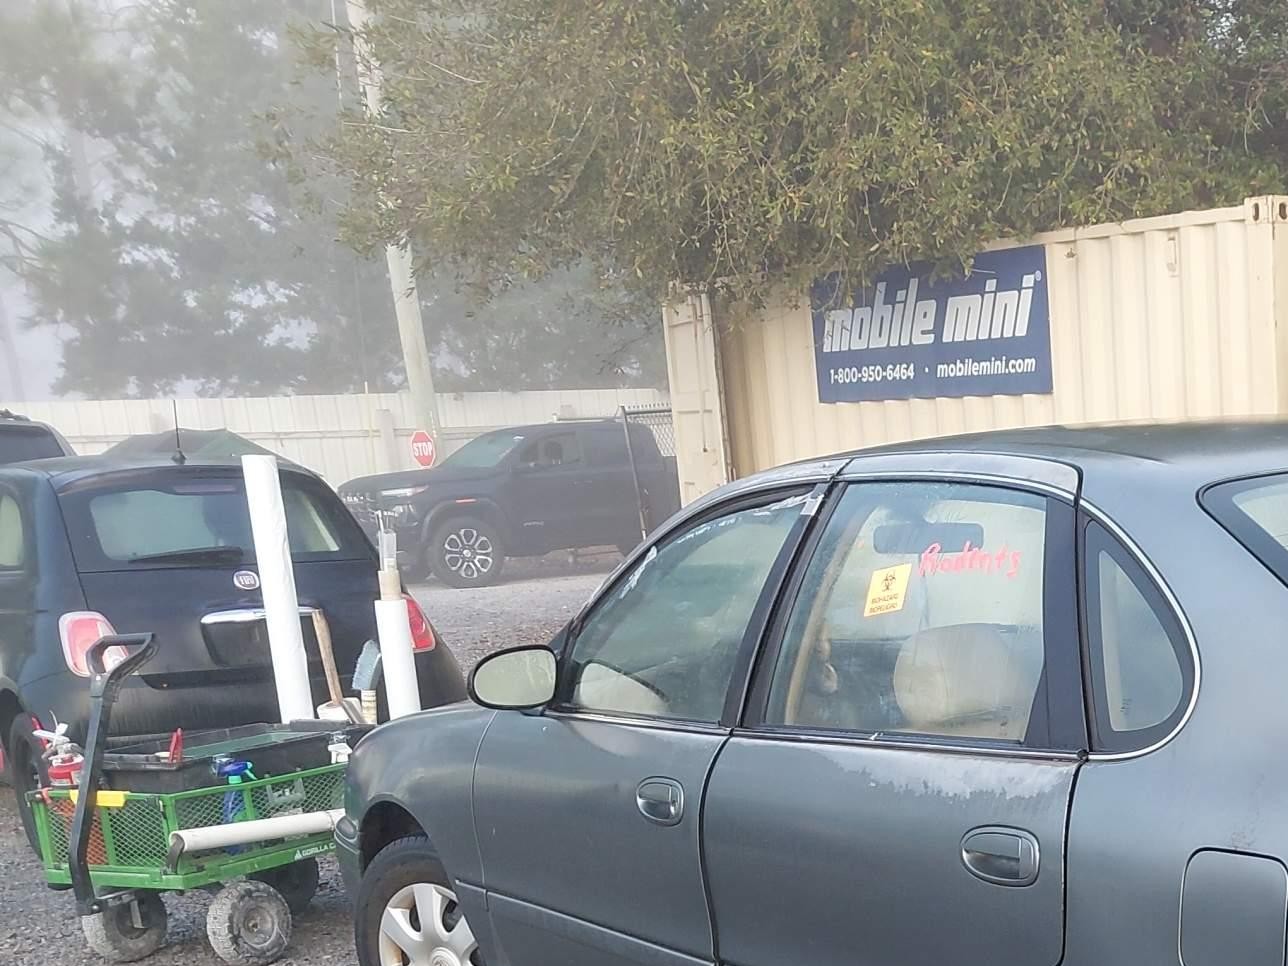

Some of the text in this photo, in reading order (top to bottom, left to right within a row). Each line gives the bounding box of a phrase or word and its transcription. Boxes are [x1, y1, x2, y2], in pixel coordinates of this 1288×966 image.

[823, 274, 1035, 352] mobile mini
[830, 356, 1036, 384] 1-800-950-6464 mobilemini.com
[413, 441, 433, 457] STOP
